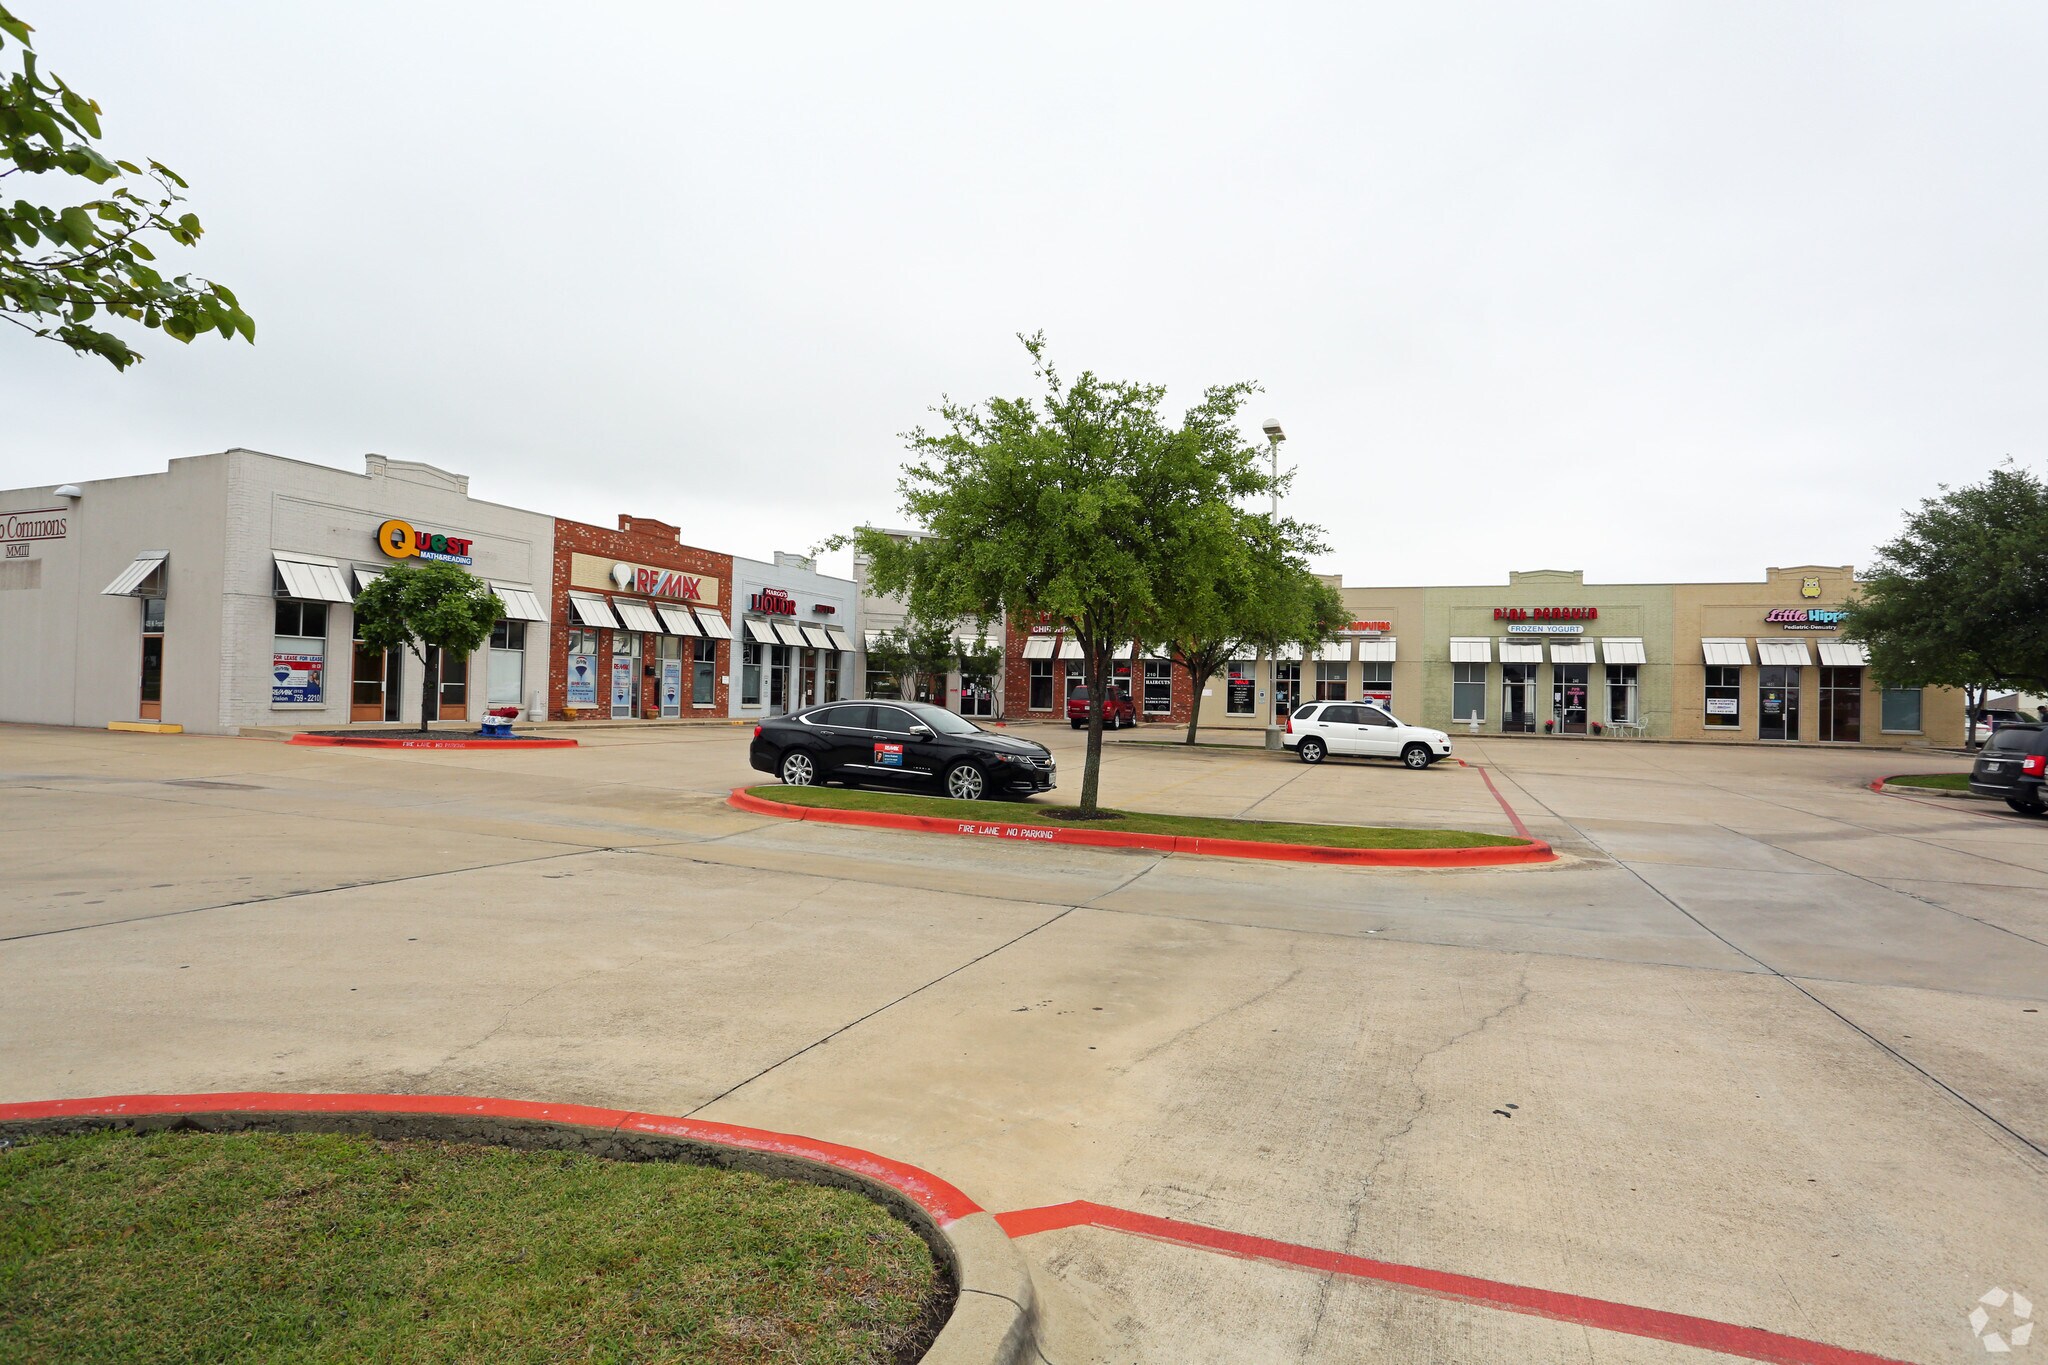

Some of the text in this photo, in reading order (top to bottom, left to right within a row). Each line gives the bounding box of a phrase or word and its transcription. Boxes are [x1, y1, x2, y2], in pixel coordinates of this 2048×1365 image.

[7, 516, 67, 538] Commons
[6, 545, 30, 557] MMIII
[420, 551, 471, 564] MATH&READING
[634, 567, 702, 600] RE/MAX
[751, 594, 797, 615] LIQUOR
[1766, 609, 1808, 622] Little
[957, 824, 1054, 839] FIRE LANE NO PARKING
